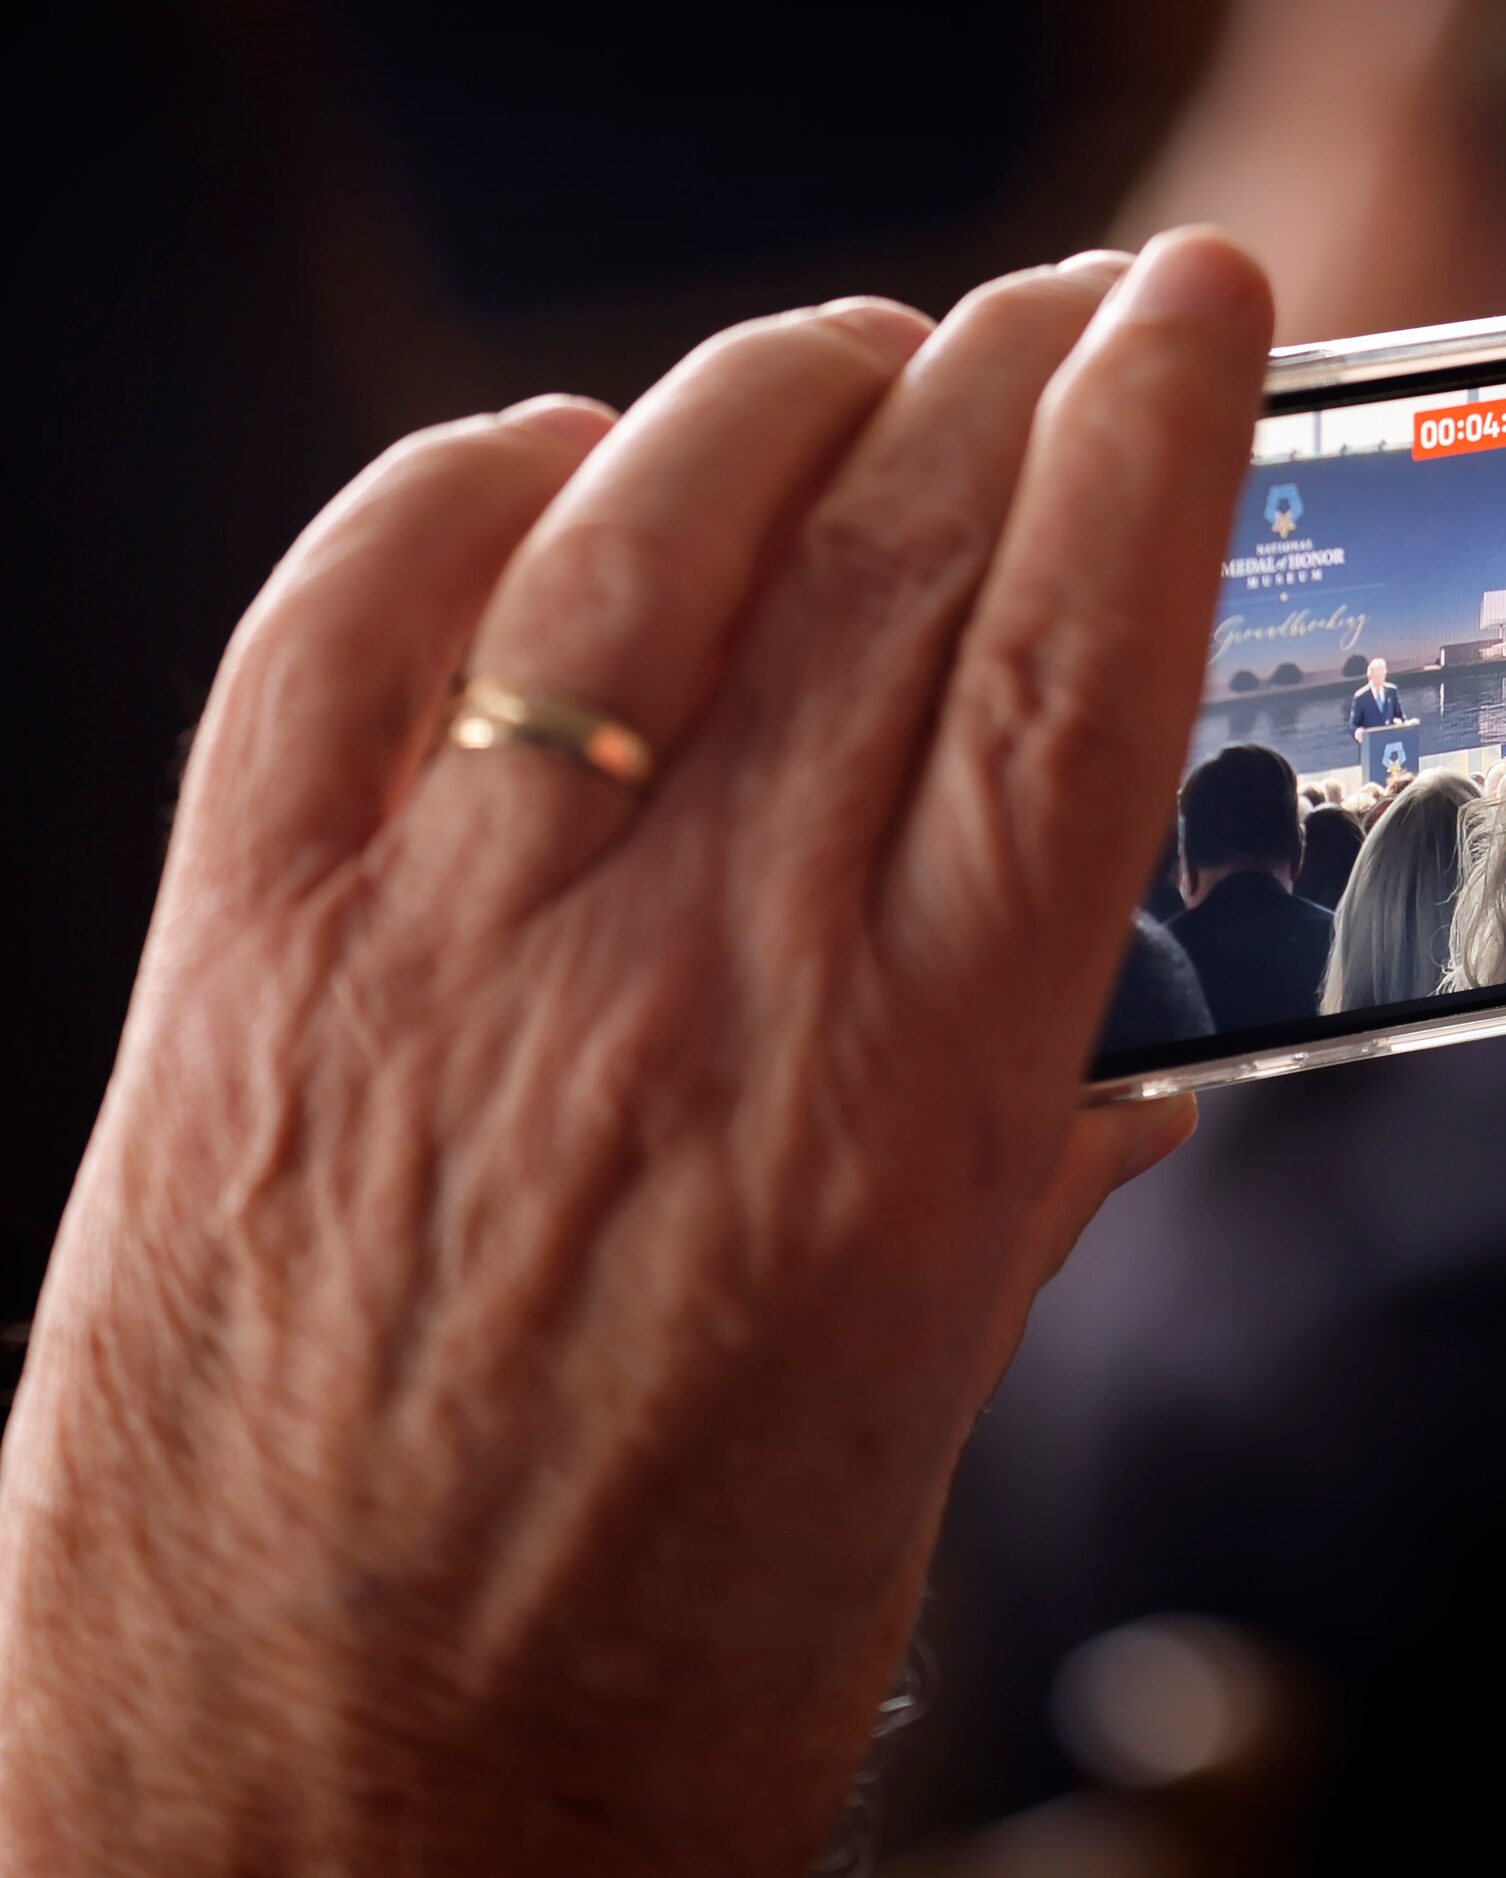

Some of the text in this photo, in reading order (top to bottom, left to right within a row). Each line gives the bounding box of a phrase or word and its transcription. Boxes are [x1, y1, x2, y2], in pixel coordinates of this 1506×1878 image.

[1255, 538, 1313, 556] NATIONAL
[1220, 547, 1345, 578] MEDAL of HONOR
[1246, 568, 1323, 590] MUSEUM
